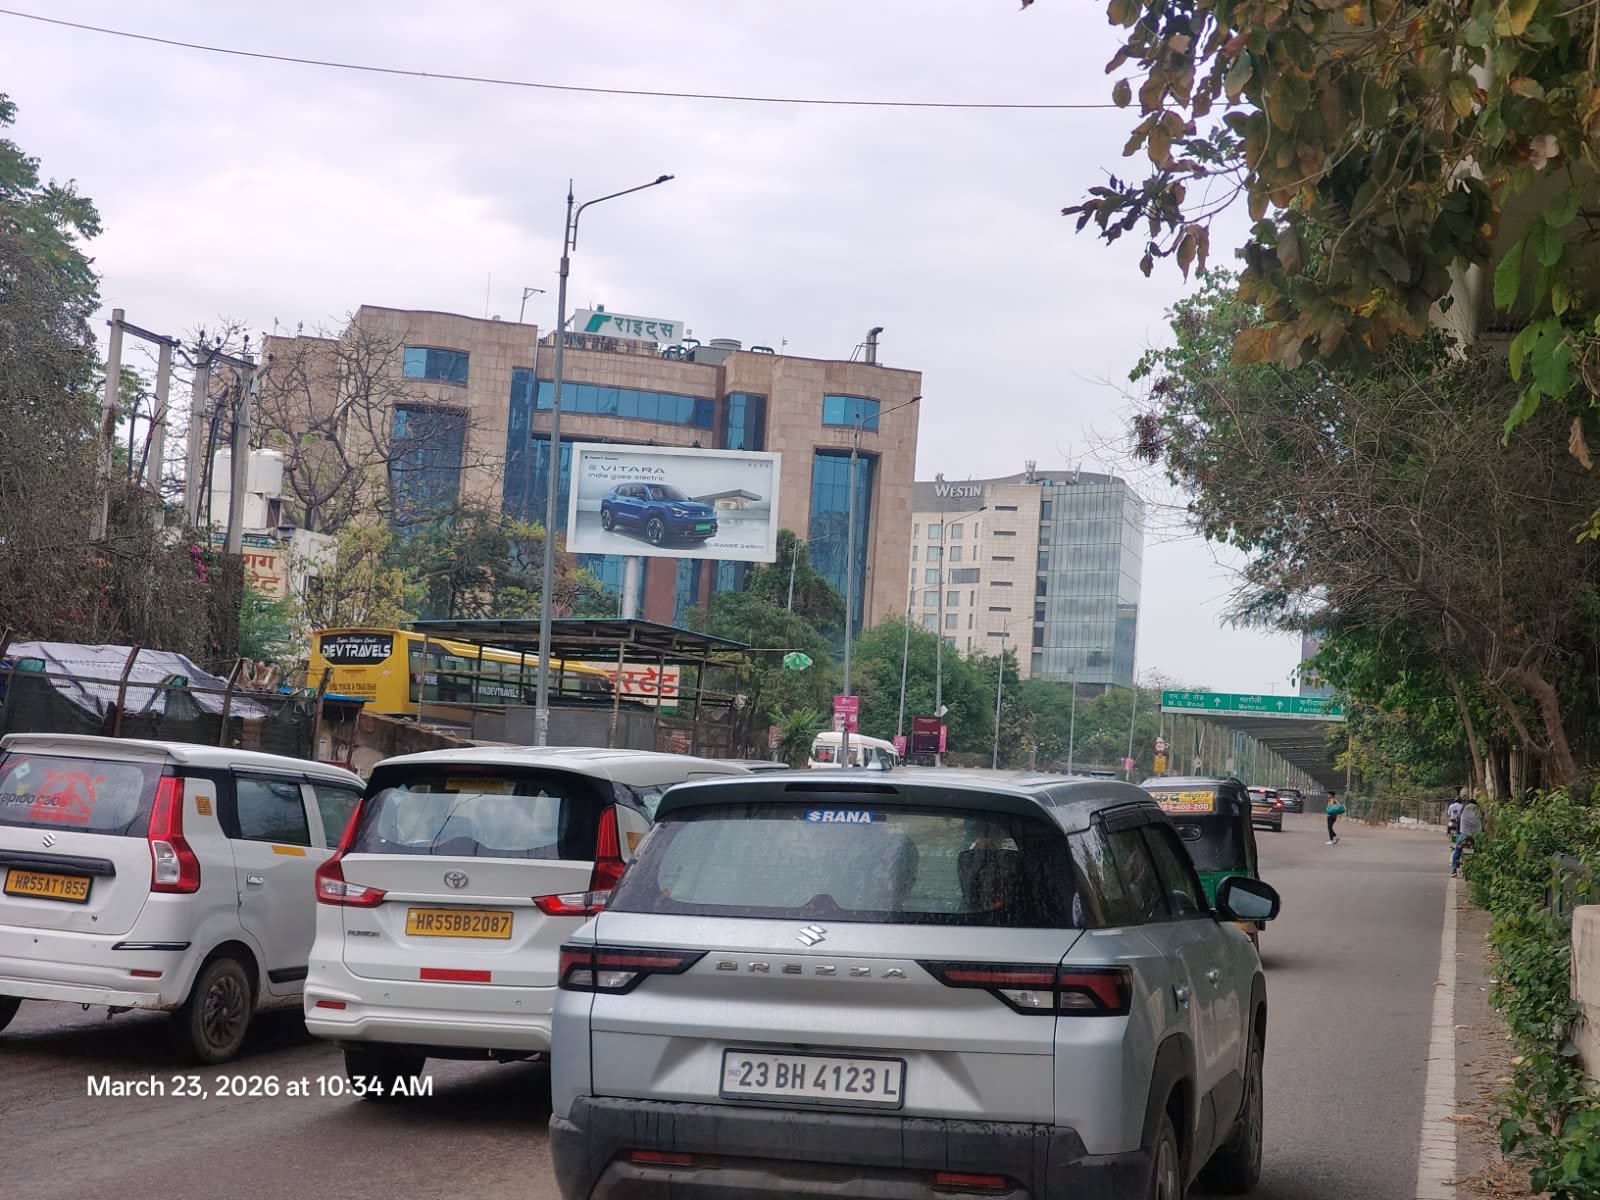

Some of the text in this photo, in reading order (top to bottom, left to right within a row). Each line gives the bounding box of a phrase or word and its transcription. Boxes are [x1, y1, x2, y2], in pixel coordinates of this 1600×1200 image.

[613, 317, 675, 340] राइट्स
[600, 465, 665, 474] VITARA
[322, 644, 391, 658] DEV TRAVELS
[822, 810, 871, 824] RANA
[15, 874, 87, 896] HR55AT1855
[415, 913, 510, 933] HR55BB2087
[716, 960, 907, 979] BREZZA
[739, 1061, 769, 1088] 23
[775, 1062, 806, 1090] BH
[813, 1064, 877, 1094] 4123
[883, 1068, 897, 1096] L
